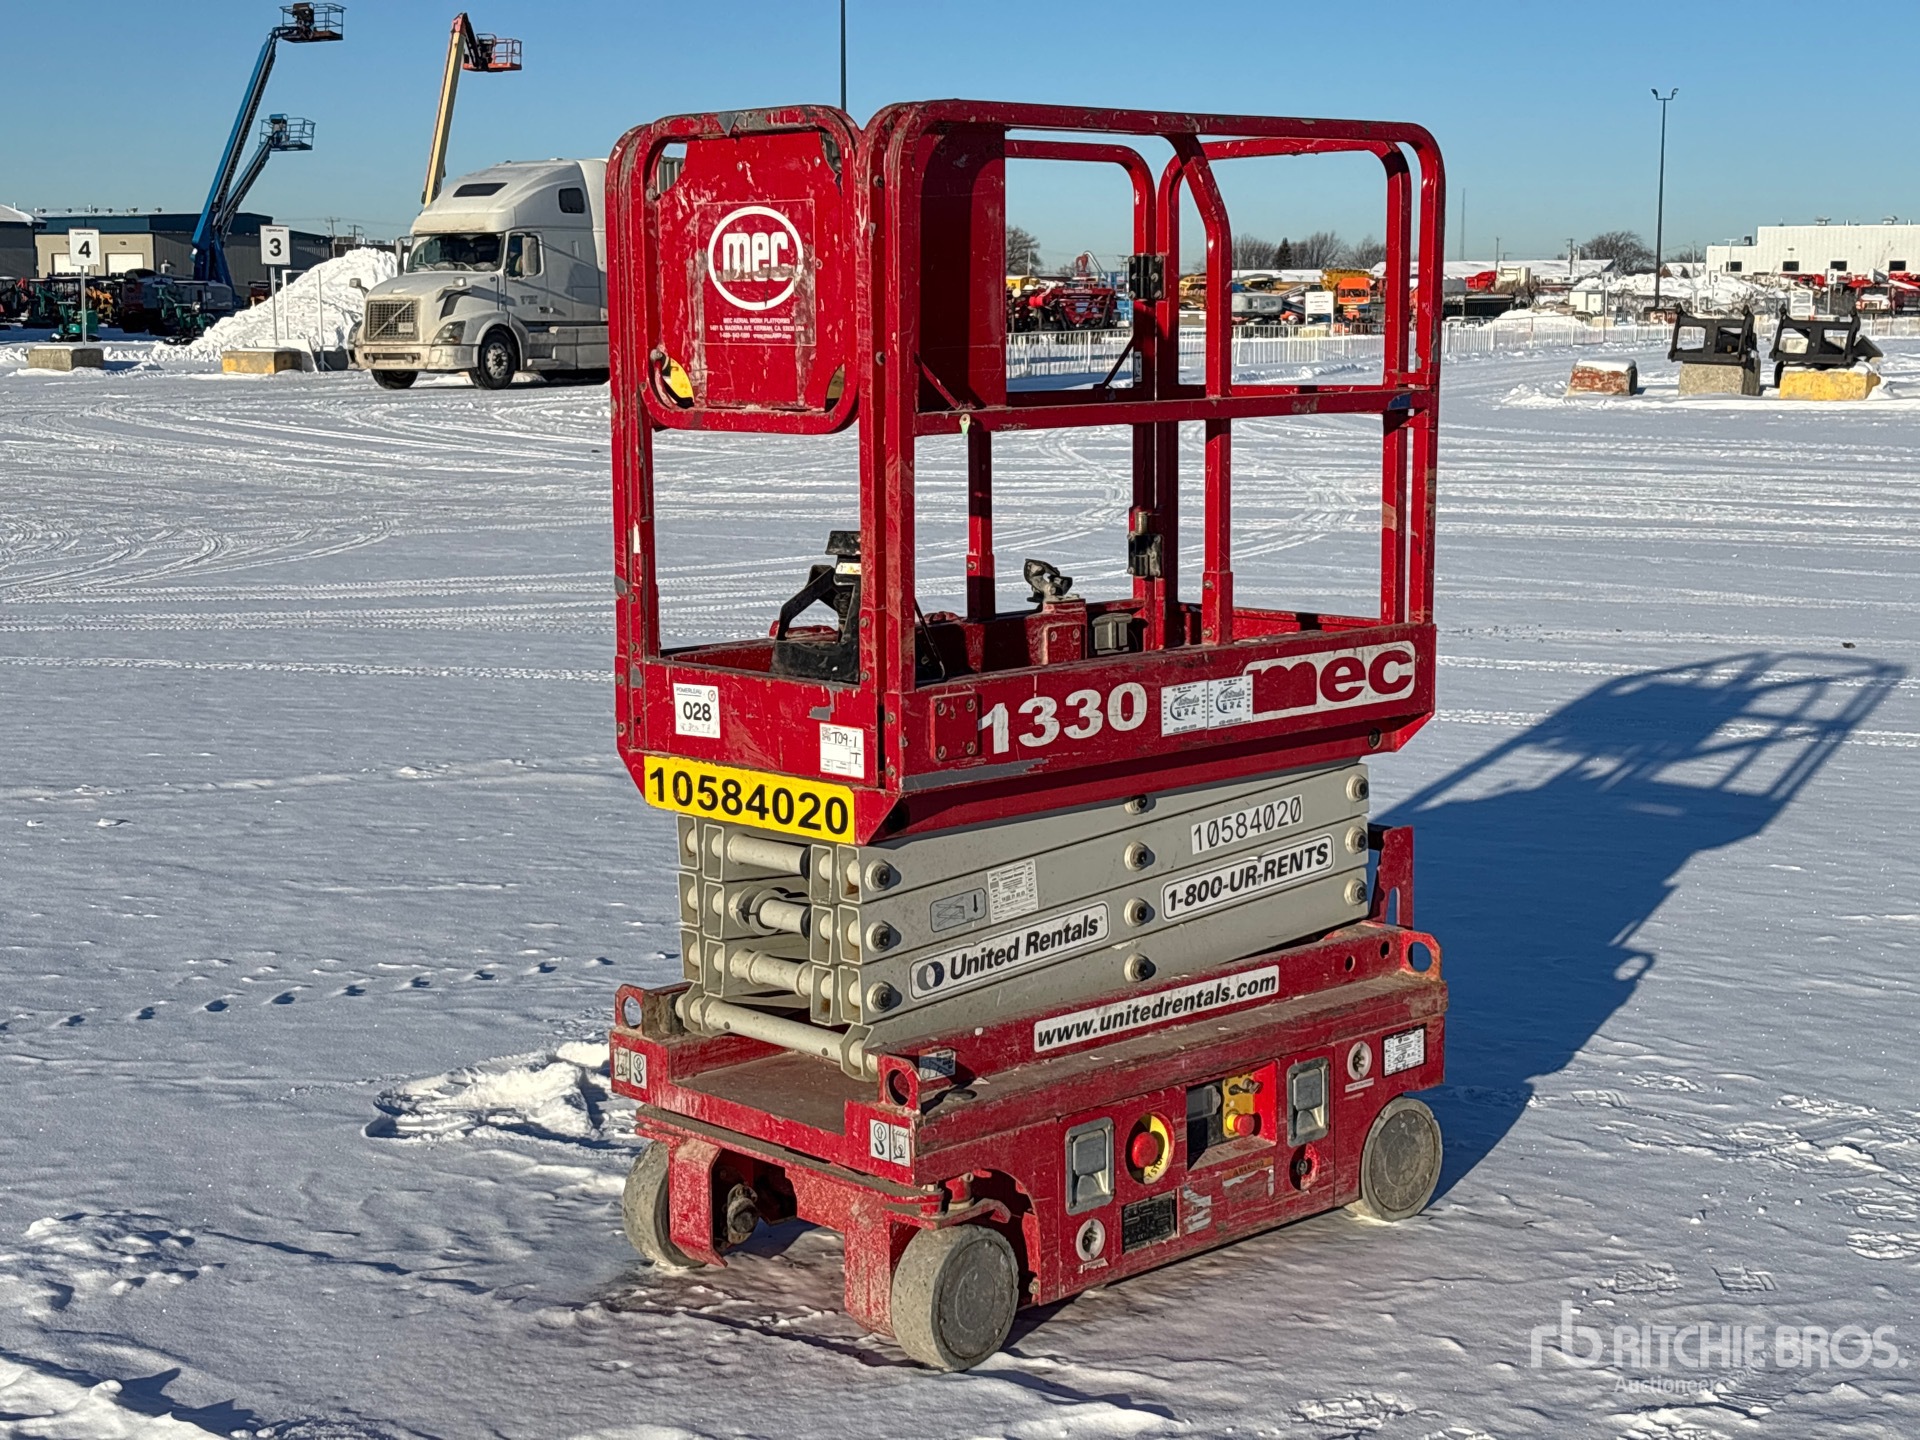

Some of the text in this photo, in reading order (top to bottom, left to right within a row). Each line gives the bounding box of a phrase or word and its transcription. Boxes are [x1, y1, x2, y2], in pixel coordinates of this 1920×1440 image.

[78, 240, 92, 259] 4
[269, 237, 282, 257] 3
[683, 701, 712, 722] 028
[1246, 649, 1413, 714] mec
[977, 682, 1148, 755] 1330
[649, 766, 849, 836] 10584020
[1193, 795, 1302, 852] 10584020
[1168, 842, 1329, 911] 1-800-UR-RENTS
[950, 915, 1099, 980] United Rentals
[1037, 975, 1277, 1048] www.unitedrentals.com
